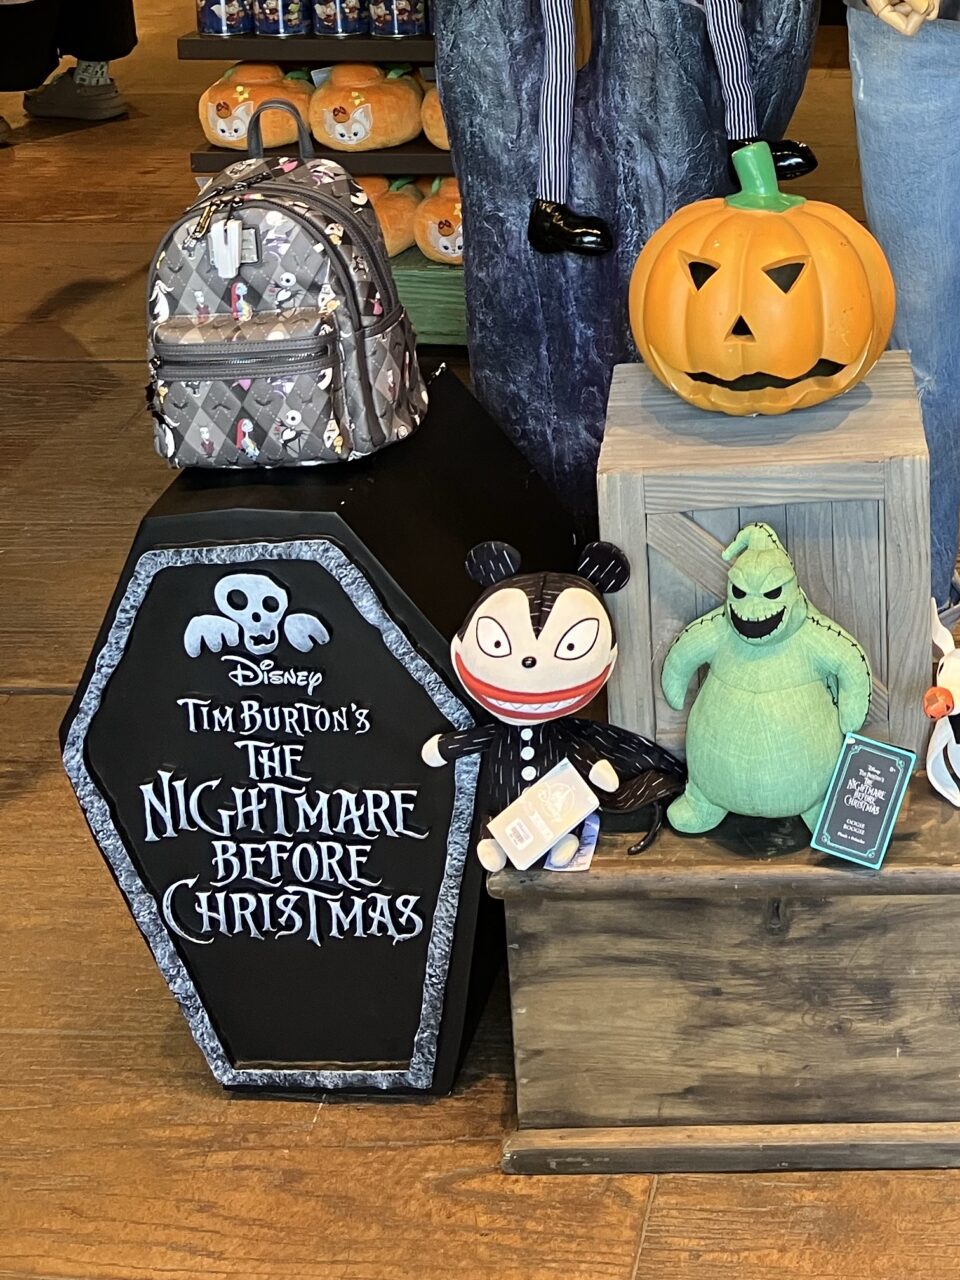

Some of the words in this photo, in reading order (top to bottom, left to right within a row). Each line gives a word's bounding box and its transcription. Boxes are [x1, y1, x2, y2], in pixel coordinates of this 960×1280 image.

[221, 654, 323, 696] Disney
[176, 697, 236, 733] TIM
[239, 701, 371, 737] BURTON'S
[233, 740, 312, 783] THE
[138, 770, 430, 842] NIGHTMARE
[209, 841, 383, 892] BEFORE
[162, 874, 424, 947] CHRISTMAS
